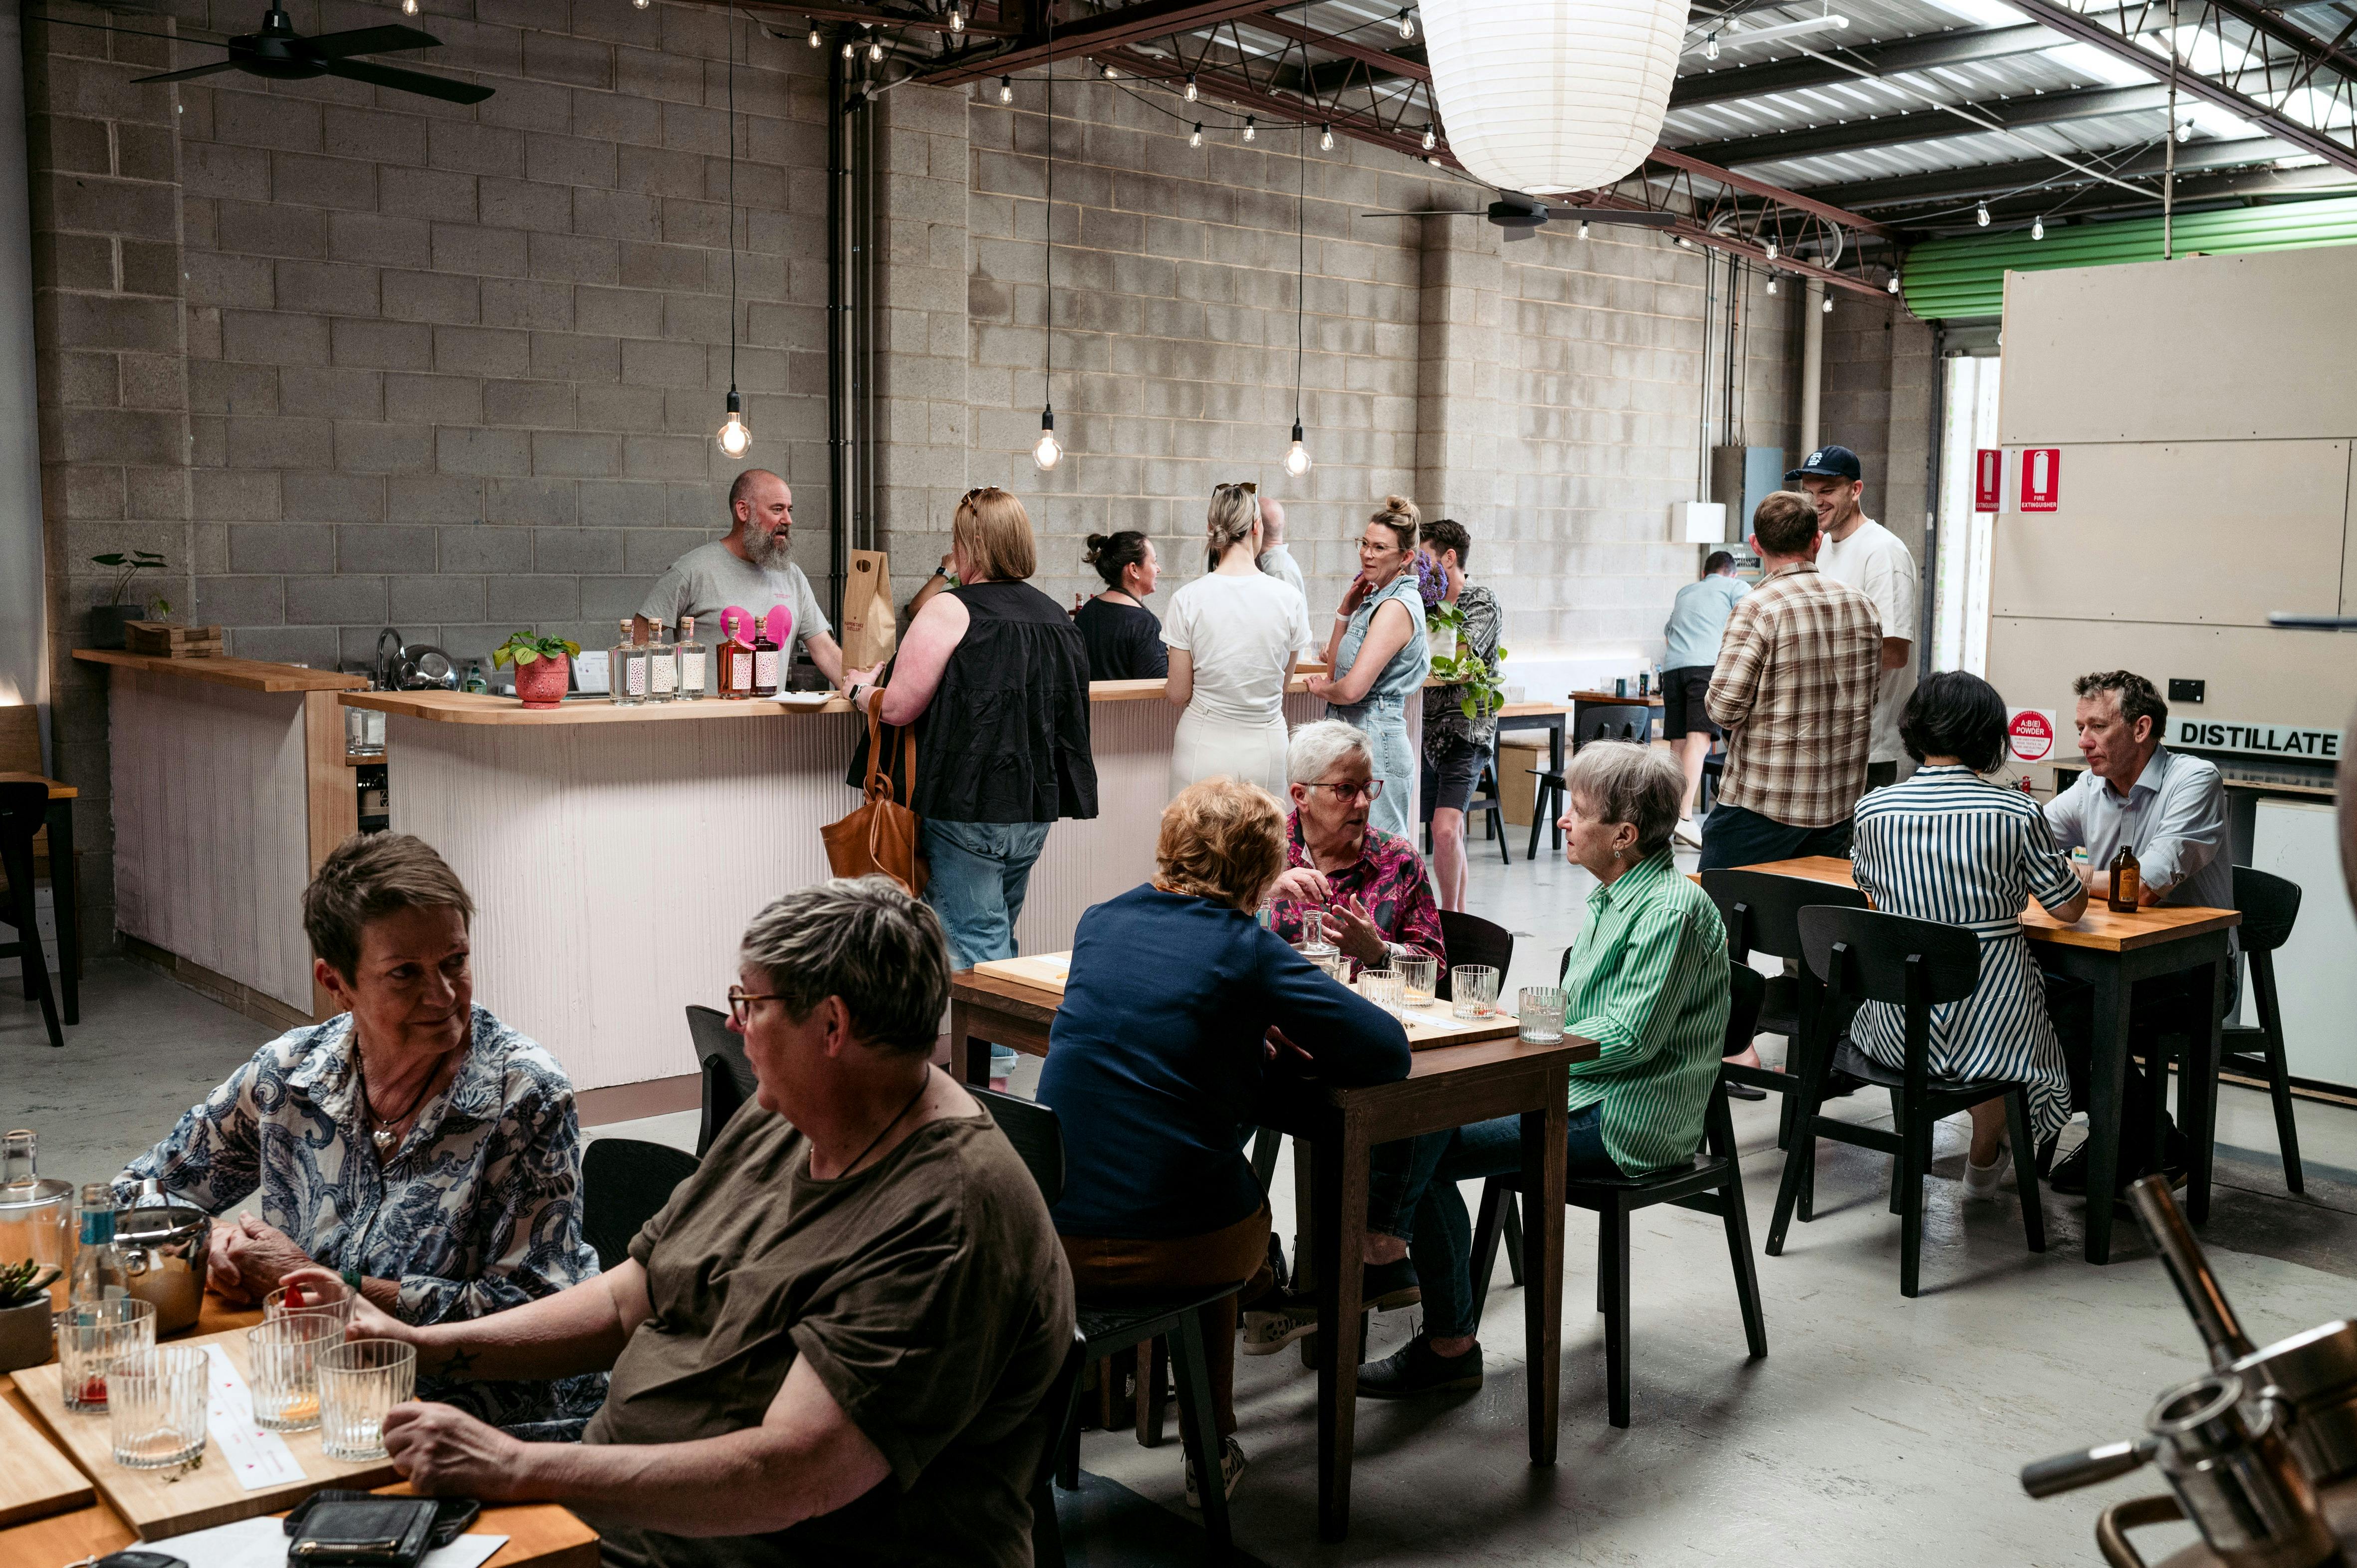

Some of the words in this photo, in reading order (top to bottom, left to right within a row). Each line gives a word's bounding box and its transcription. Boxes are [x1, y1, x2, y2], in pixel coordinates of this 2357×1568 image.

[2015, 711, 2032, 720] COLOURED
[2021, 719, 2040, 728] A:B(E)
[2016, 726, 2044, 735] POWDER
[2180, 722, 2338, 755] DISTILLATE
